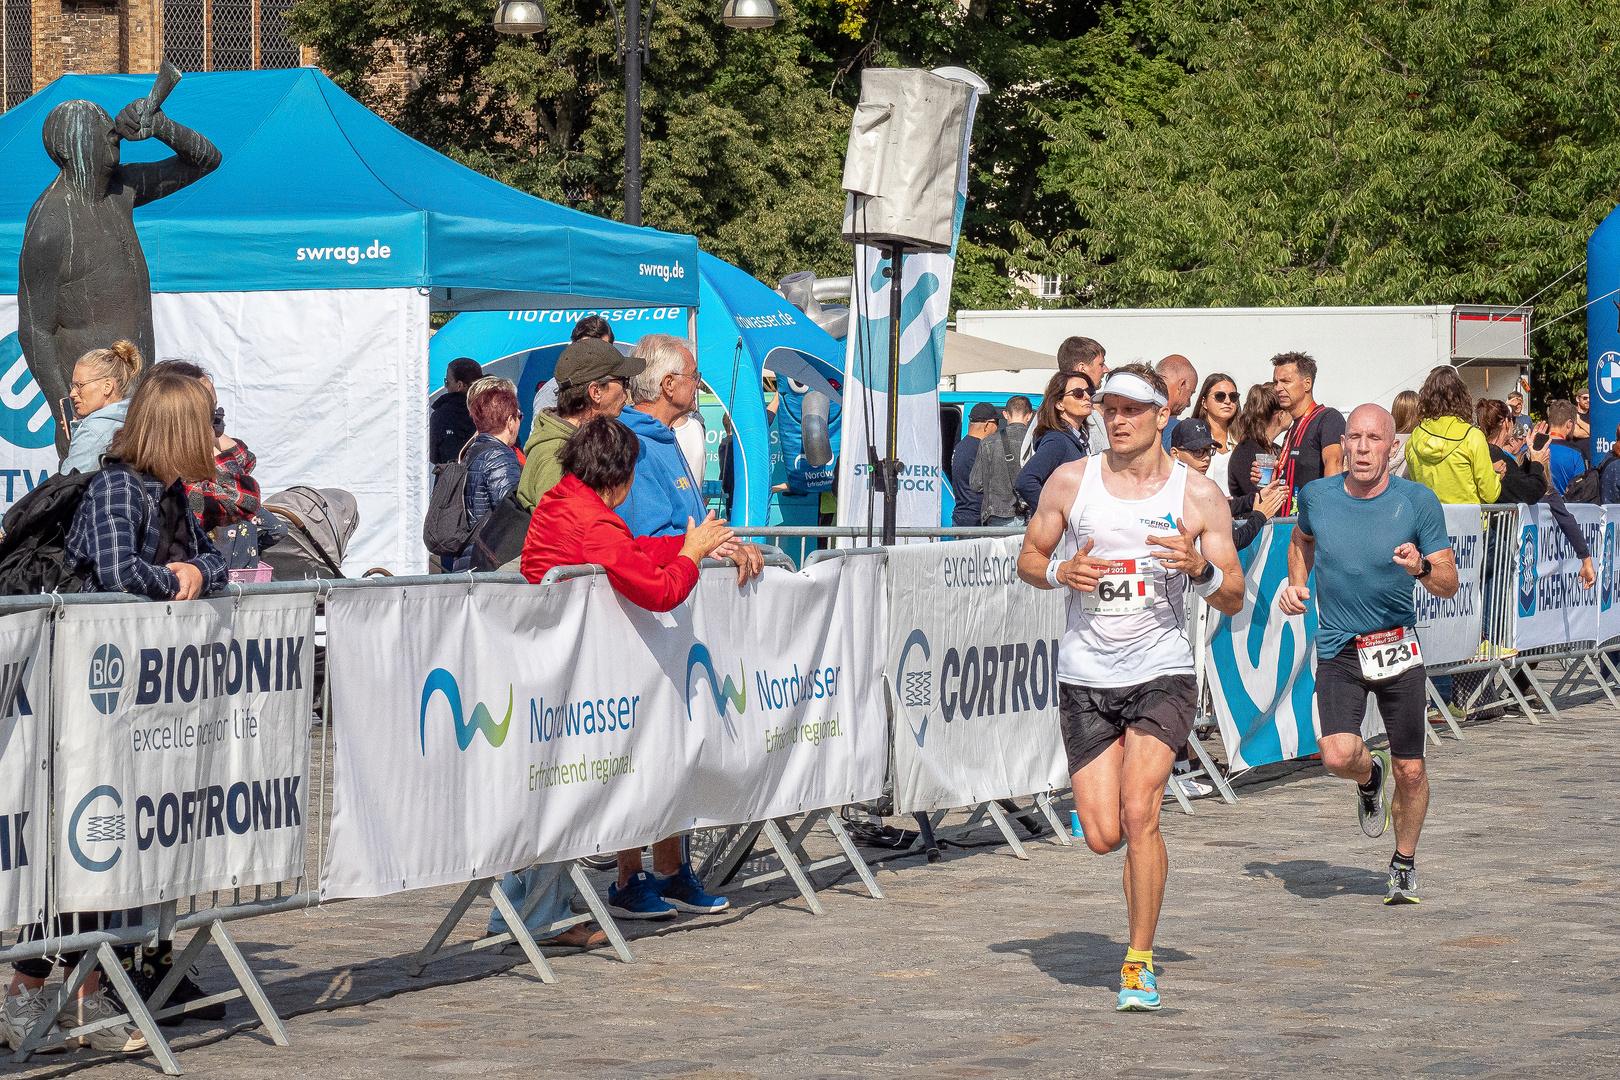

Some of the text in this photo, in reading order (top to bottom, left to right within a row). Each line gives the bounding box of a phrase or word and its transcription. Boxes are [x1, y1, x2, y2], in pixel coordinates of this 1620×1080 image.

[296, 239, 391, 265] swrag.de
[639, 260, 685, 282] swrag.de
[804, 469, 834, 479] Nordw
[854, 463, 939, 477] STWERK
[944, 544, 1017, 588] excellence
[1099, 580, 1133, 602] 64
[1365, 634, 1400, 647] Citylauf 2021
[135, 635, 305, 706] BIOTRONIK
[1372, 644, 1412, 668] 123
[93, 657, 124, 686] BIO
[133, 718, 211, 752] excellence
[233, 707, 258, 741] life
[530, 690, 640, 743] Nordwasser
[800, 711, 843, 746] regional.
[529, 747, 635, 791] Erfrischend regional.
[135, 775, 301, 851] CORTRONIK
